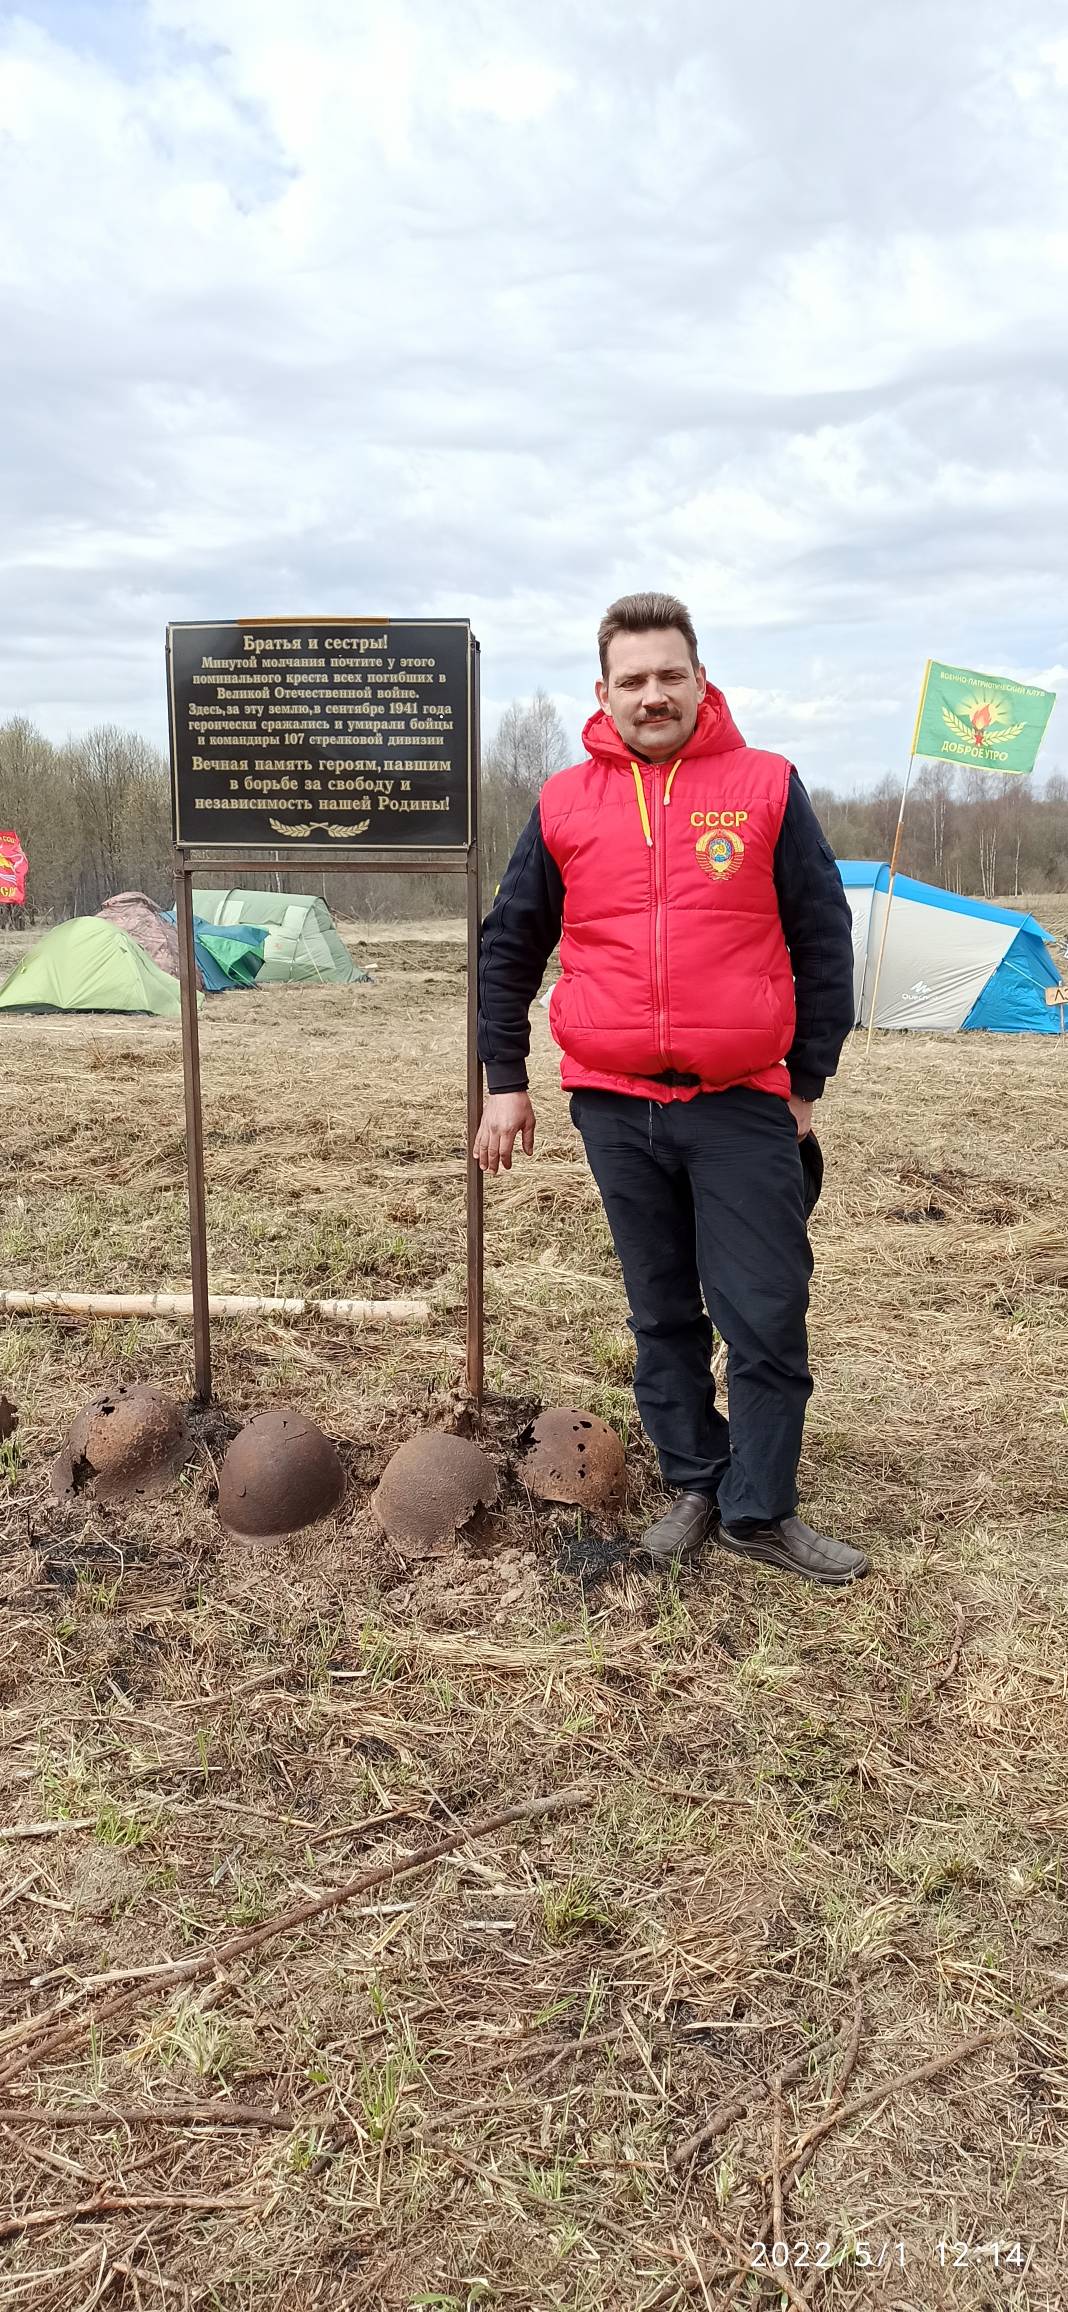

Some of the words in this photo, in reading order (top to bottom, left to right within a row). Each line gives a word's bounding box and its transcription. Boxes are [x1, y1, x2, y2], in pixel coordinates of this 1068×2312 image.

[243, 635, 301, 653] Братья
[308, 638, 318, 649] и
[324, 635, 388, 653] сестры!
[202, 656, 257, 670] Минутой
[262, 657, 325, 667] молчания
[330, 657, 382, 667] почтите
[388, 658, 395, 669] у
[400, 657, 435, 667] этого
[193, 673, 281, 683] поминального
[286, 673, 328, 686] креста
[333, 673, 362, 683] всех
[368, 672, 433, 683] погибших
[439, 674, 446, 683] в
[217, 687, 270, 699] Великой
[274, 687, 371, 699] Отечественной
[377, 688, 419, 699] войне.
[245, 705, 263, 716] эту
[326, 703, 385, 716] сентябре
[389, 703, 418, 714] 1941
[423, 704, 452, 716] года
[188, 720, 256, 732] героически
[261, 720, 330, 732] сражались
[335, 720, 342, 729] и
[347, 720, 405, 732] умирали
[410, 718, 454, 731] бойцы
[198, 736, 205, 745] и
[209, 735, 280, 748] командиры
[285, 733, 304, 744] 107
[309, 733, 383, 747] стрелковой
[388, 735, 444, 747] дивизии
[192, 756, 248, 770] Вечная
[255, 758, 312, 770] память
[230, 779, 238, 790] в
[244, 776, 298, 793] борьбе
[304, 779, 322, 790] за
[328, 776, 394, 793] свободу
[400, 779, 411, 790] и
[195, 798, 312, 810] независимость
[319, 796, 371, 810] нашей
[378, 796, 450, 812] Родины!
[691, 811, 748, 826] СССР
